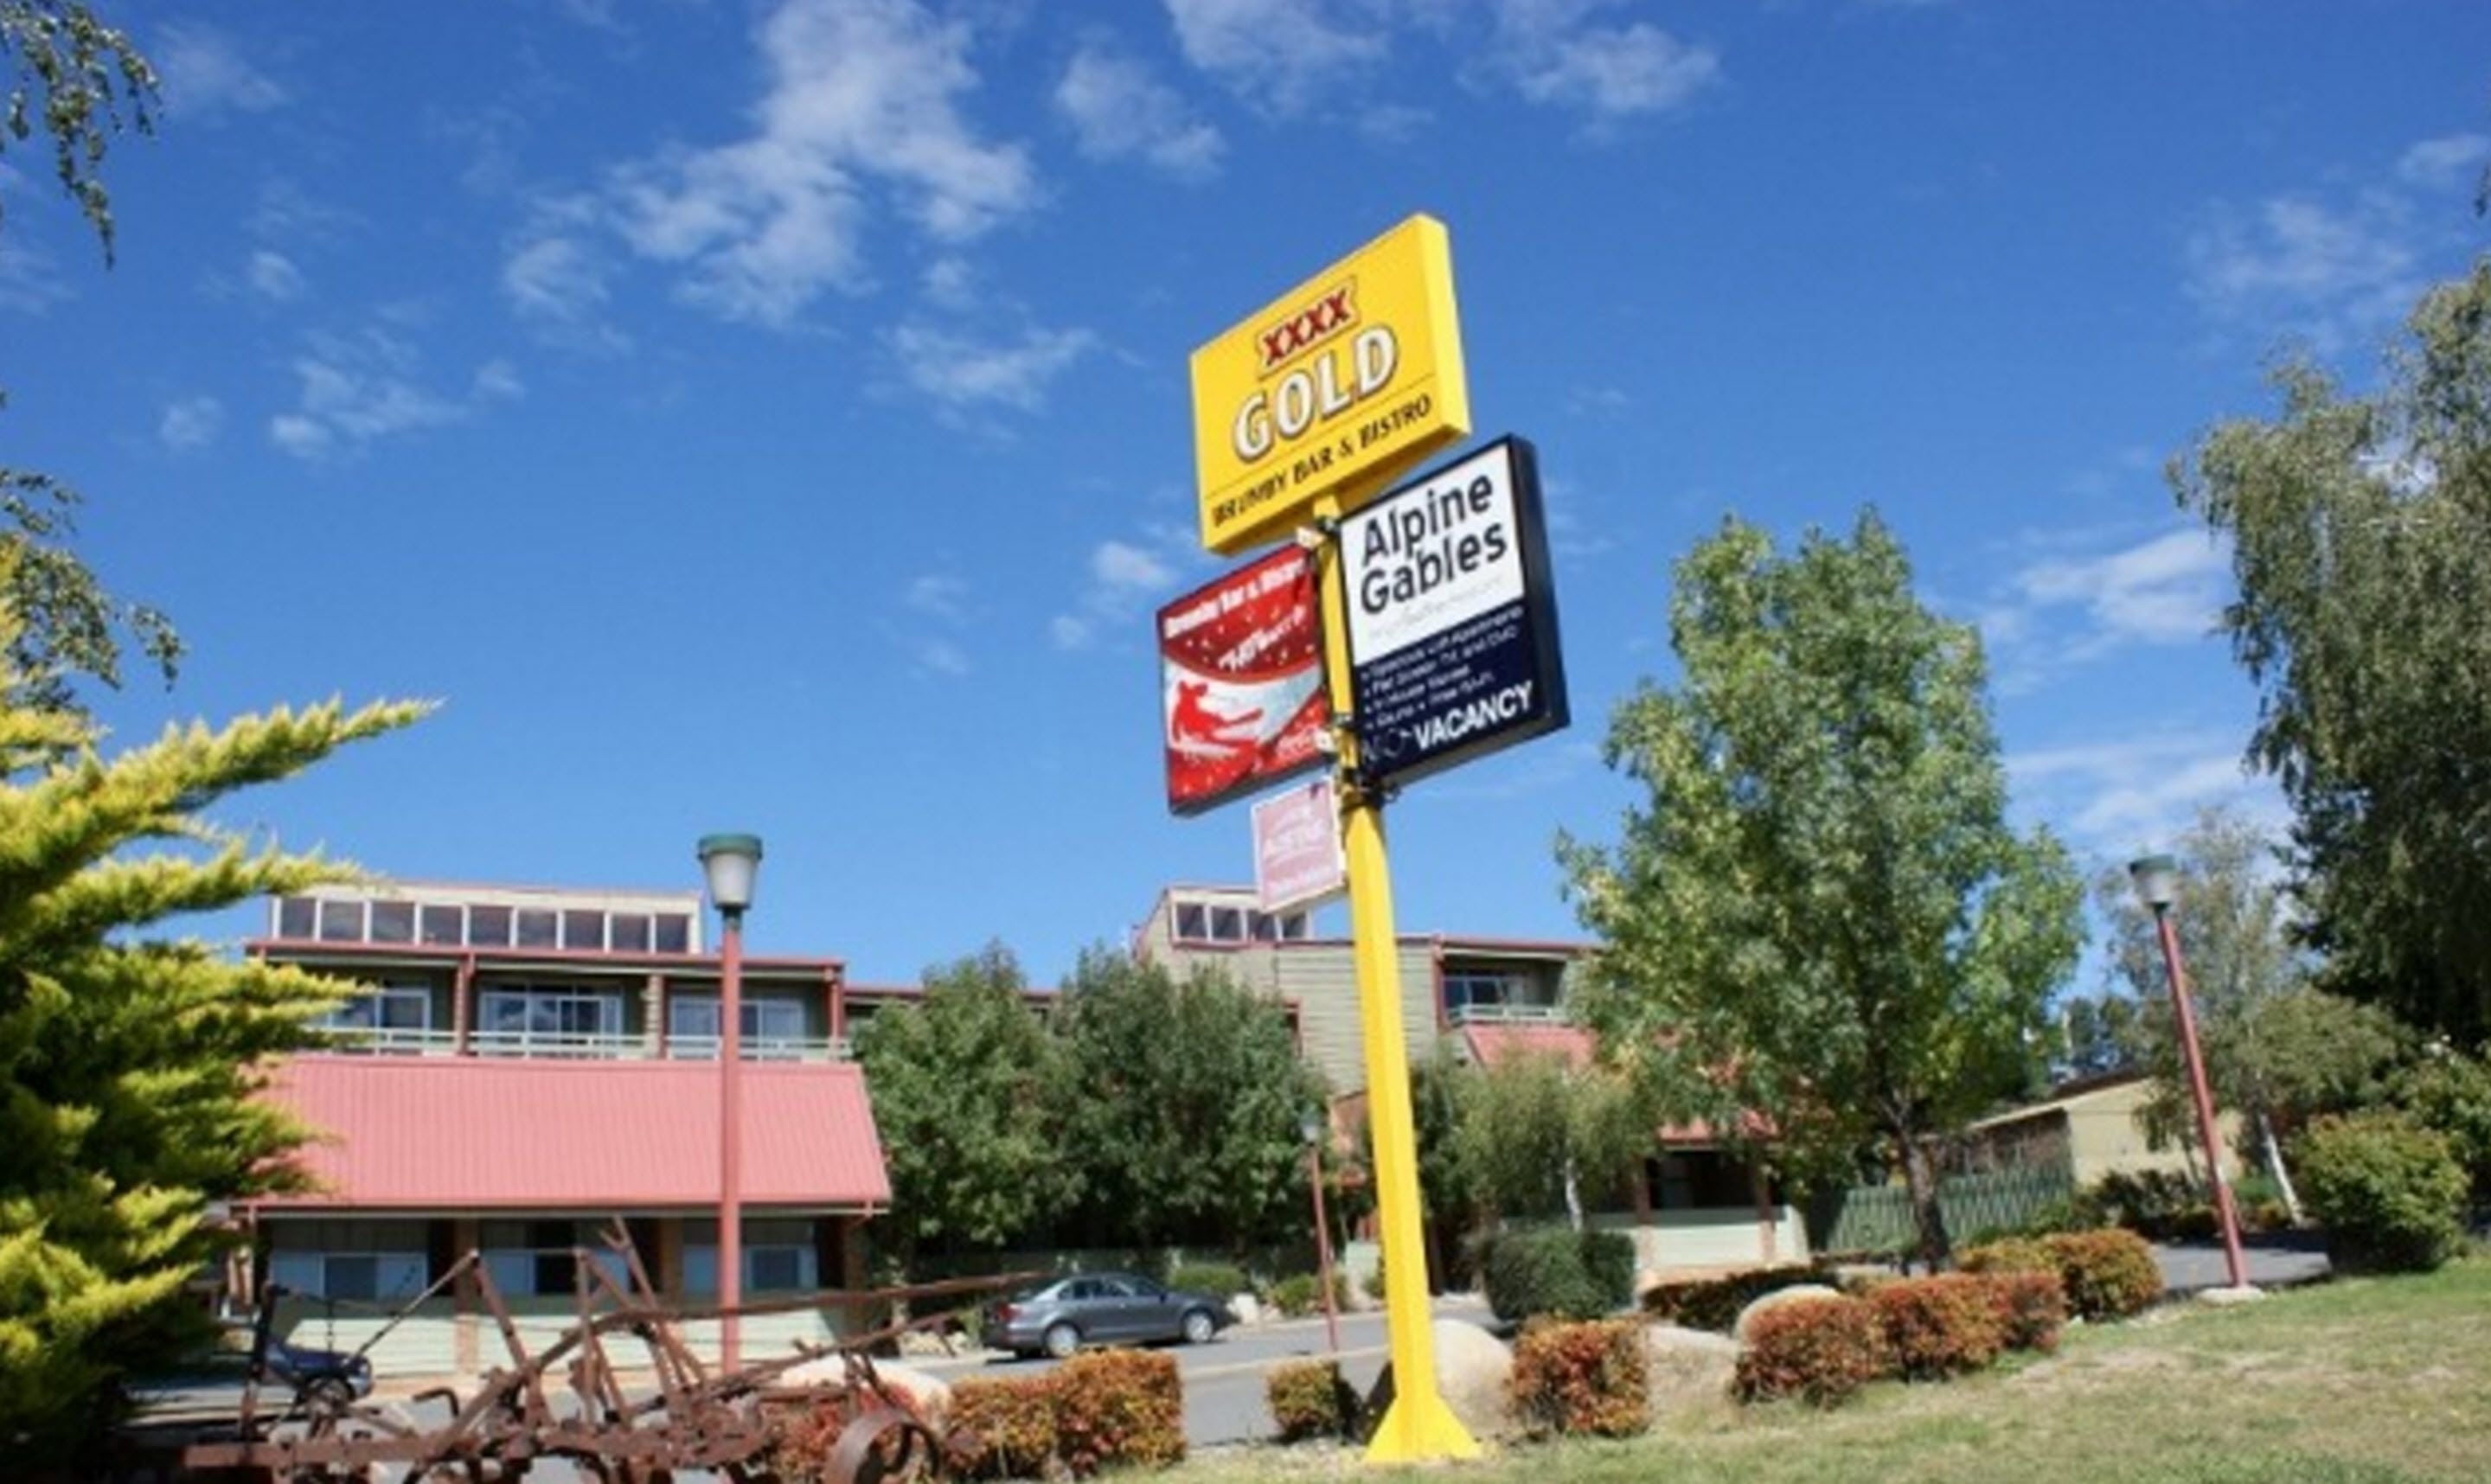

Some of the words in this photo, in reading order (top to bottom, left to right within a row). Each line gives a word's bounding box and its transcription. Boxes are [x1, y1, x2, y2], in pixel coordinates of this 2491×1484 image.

[1263, 289, 1351, 368] XXXX
[1233, 324, 1399, 464] GOLD
[1294, 445, 1334, 484] BAR
[1340, 438, 1354, 458] &
[1358, 393, 1431, 448] BISTRO
[1362, 474, 1494, 568] Alpine
[1361, 521, 1508, 615] Gables
[1414, 680, 1534, 751] VACANCY
